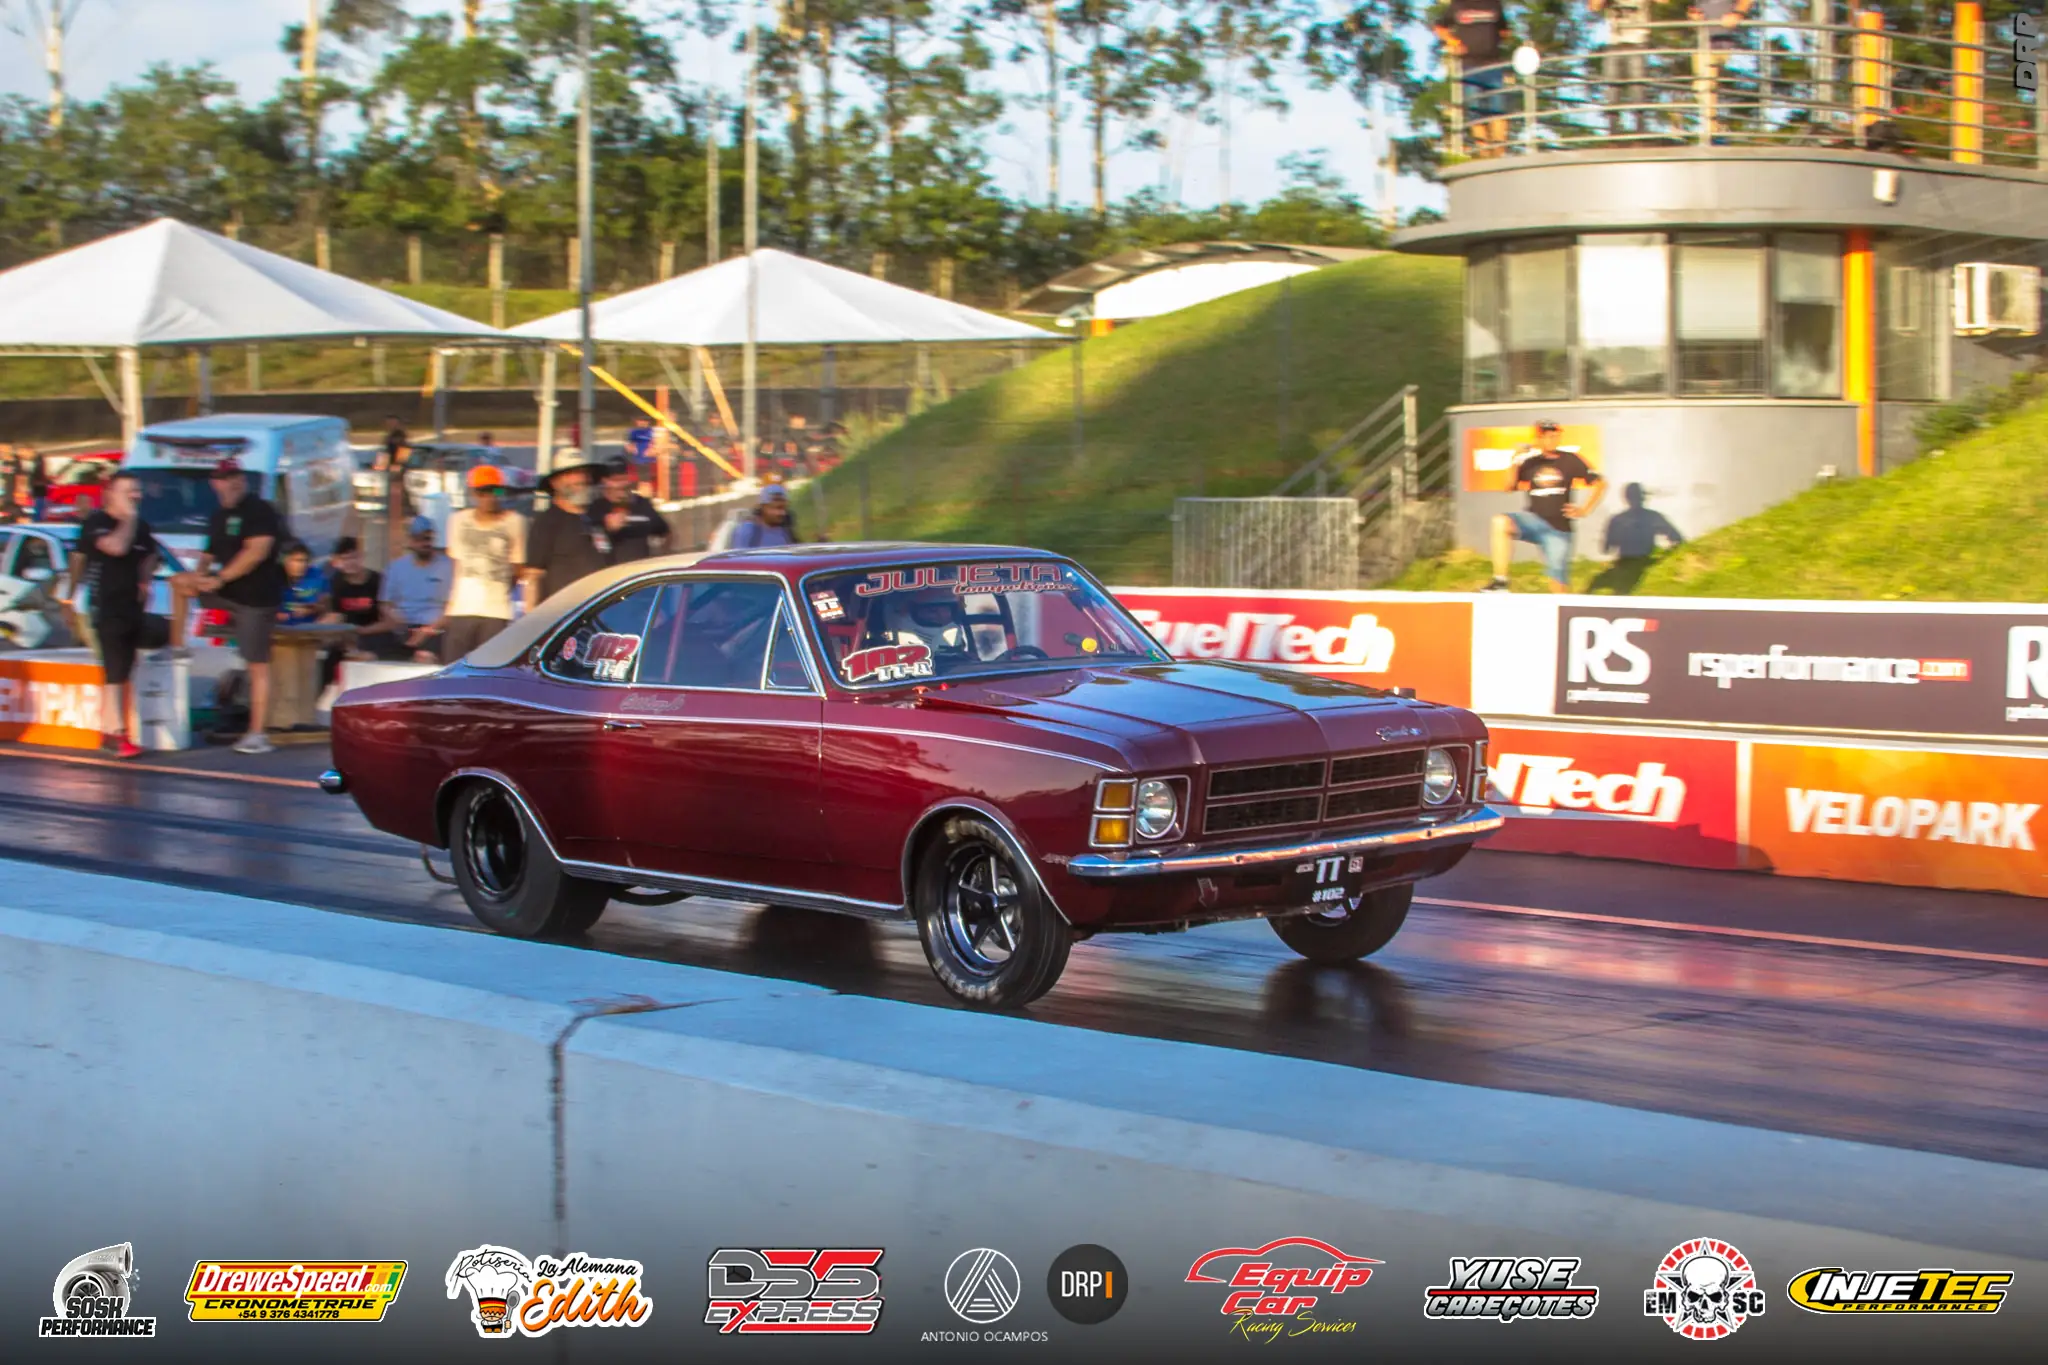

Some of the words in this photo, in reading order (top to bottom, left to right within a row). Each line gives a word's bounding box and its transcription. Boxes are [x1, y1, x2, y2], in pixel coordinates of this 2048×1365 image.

[856, 563, 1062, 597] JULIETA
[842, 644, 932, 683] 102
[1567, 616, 1659, 686] RS
[2005, 625, 2048, 700] R
[1488, 752, 1686, 822] lTech
[1786, 788, 2043, 851] VELOPARK
[1312, 887, 1346, 903] #102
[1315, 855, 1346, 884] TT
